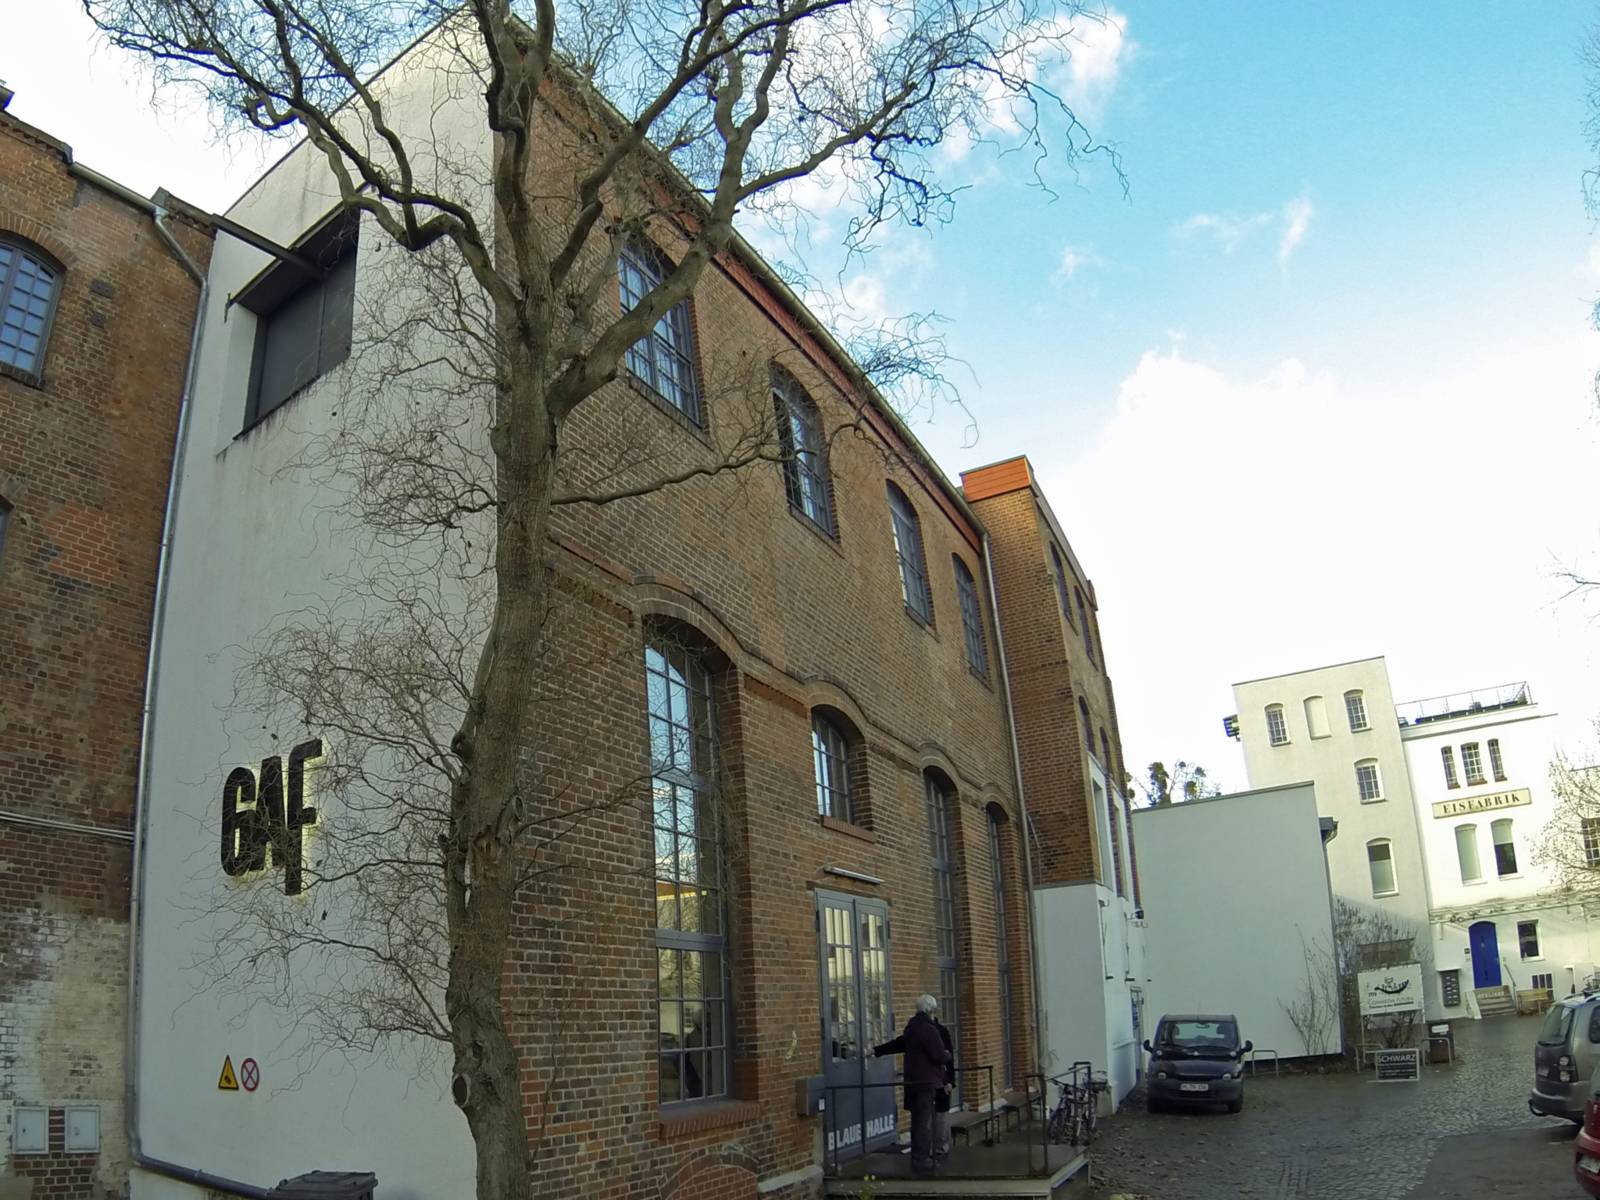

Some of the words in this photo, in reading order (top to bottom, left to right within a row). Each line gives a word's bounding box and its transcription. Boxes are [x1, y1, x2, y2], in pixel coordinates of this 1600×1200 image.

[1443, 793, 1520, 814] EISFABRIK
[828, 1123, 861, 1151] BLAUE
[866, 1114, 894, 1138] HALLE
